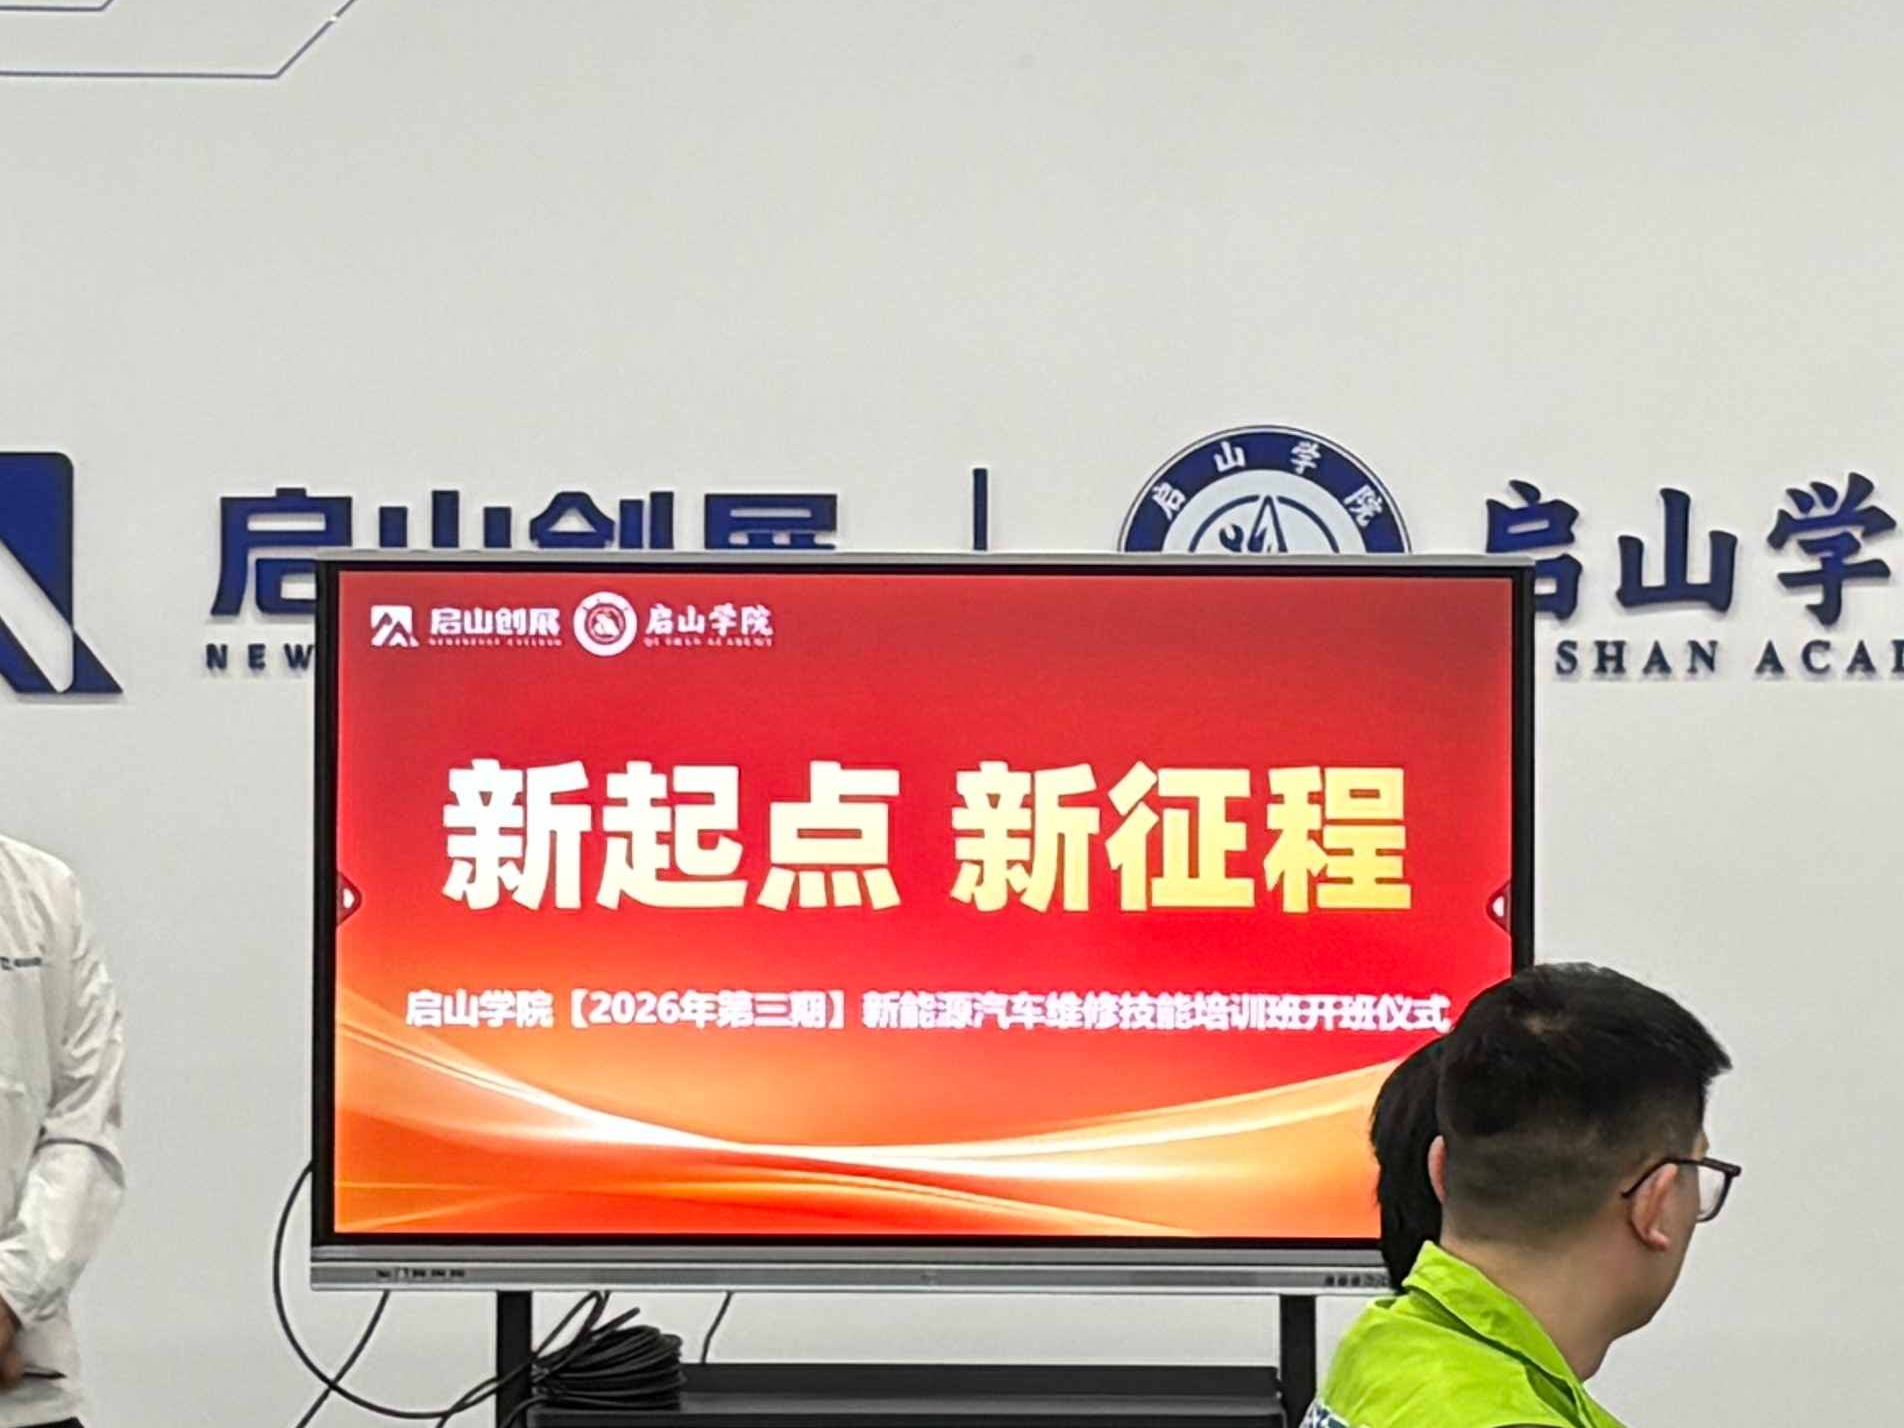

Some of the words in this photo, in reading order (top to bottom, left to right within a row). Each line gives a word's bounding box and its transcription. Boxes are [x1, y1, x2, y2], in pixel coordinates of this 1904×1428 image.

[1151, 439, 1385, 528] 启山学院
[644, 603, 774, 637] 启山学院
[1555, 639, 1719, 675] SHAN
[442, 758, 901, 911] 新起点
[950, 761, 1411, 913] 新征程
